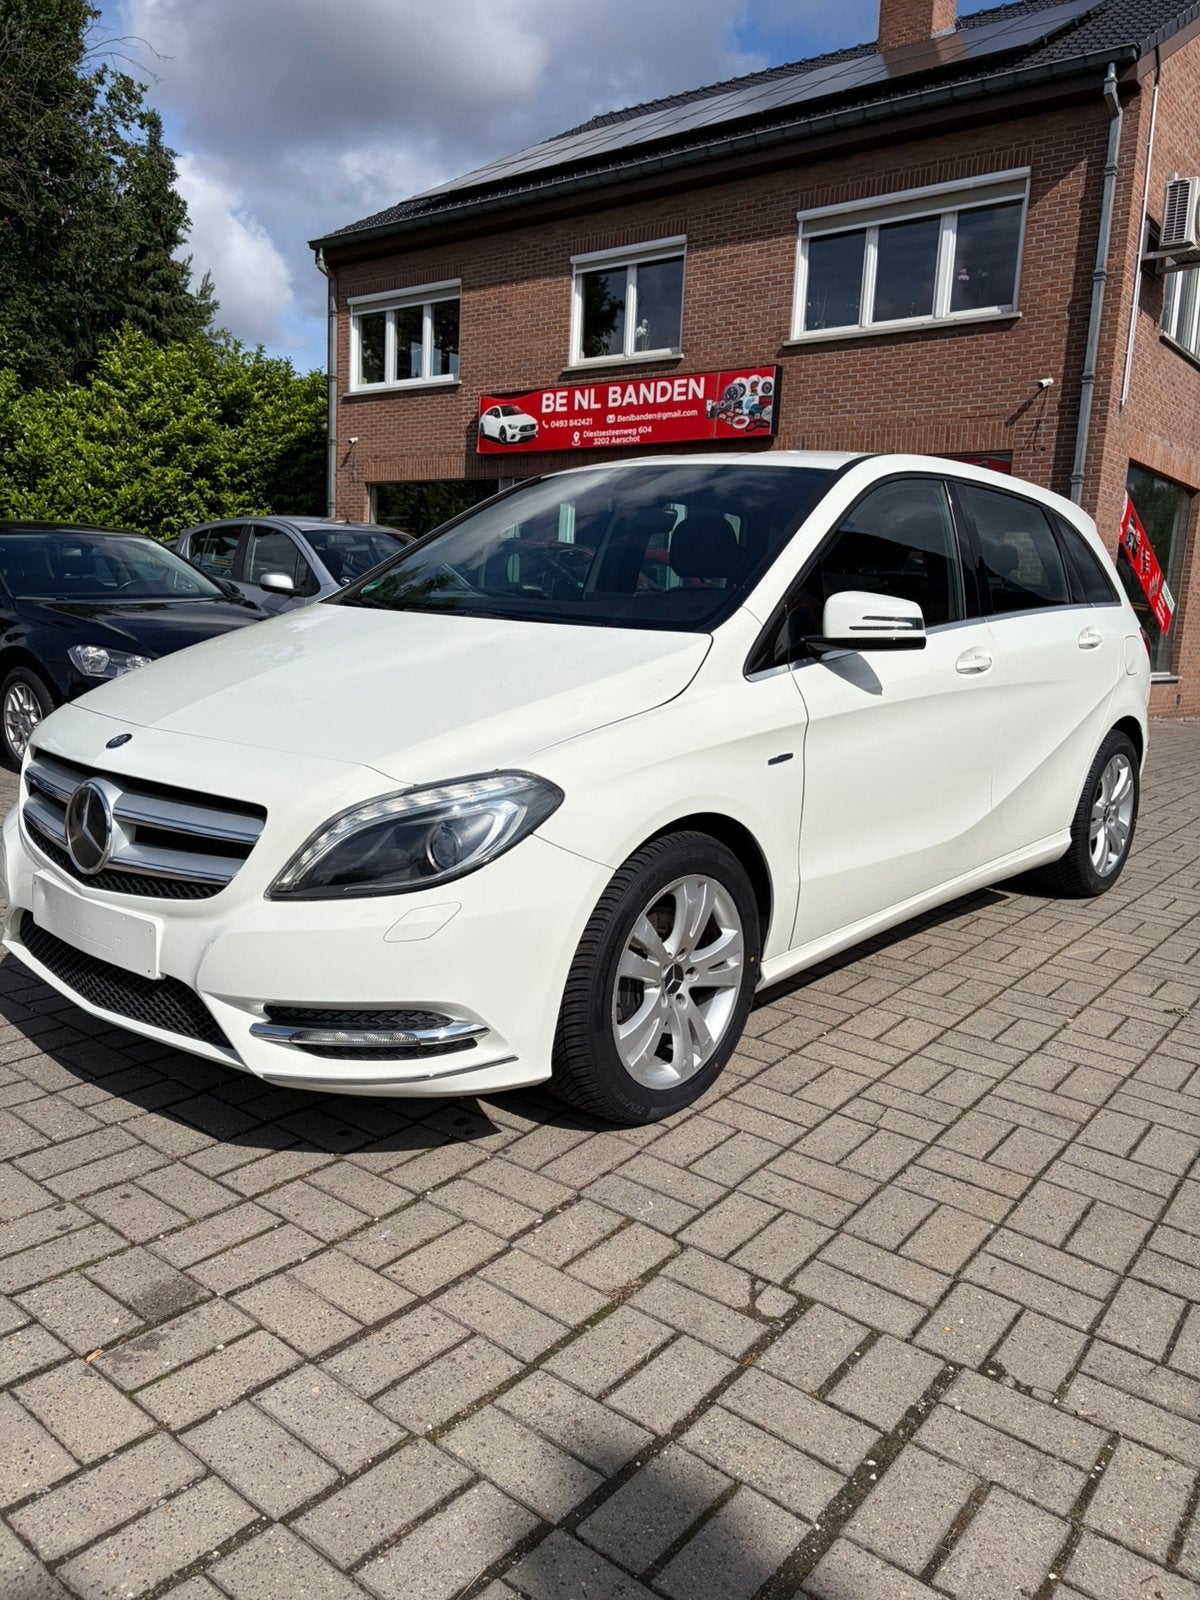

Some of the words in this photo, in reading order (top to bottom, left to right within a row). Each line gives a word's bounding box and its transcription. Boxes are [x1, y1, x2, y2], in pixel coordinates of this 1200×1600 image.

[541, 390, 569, 413] BE
[574, 388, 601, 410] NL
[607, 377, 706, 408] BANDEN
[550, 420, 568, 428] 0493
[569, 418, 593, 427] 842421
[583, 427, 637, 438] Diestsesteenweg
[638, 425, 652, 434] 604
[593, 436, 610, 445] 3202
[611, 435, 640, 444] Aarschot
